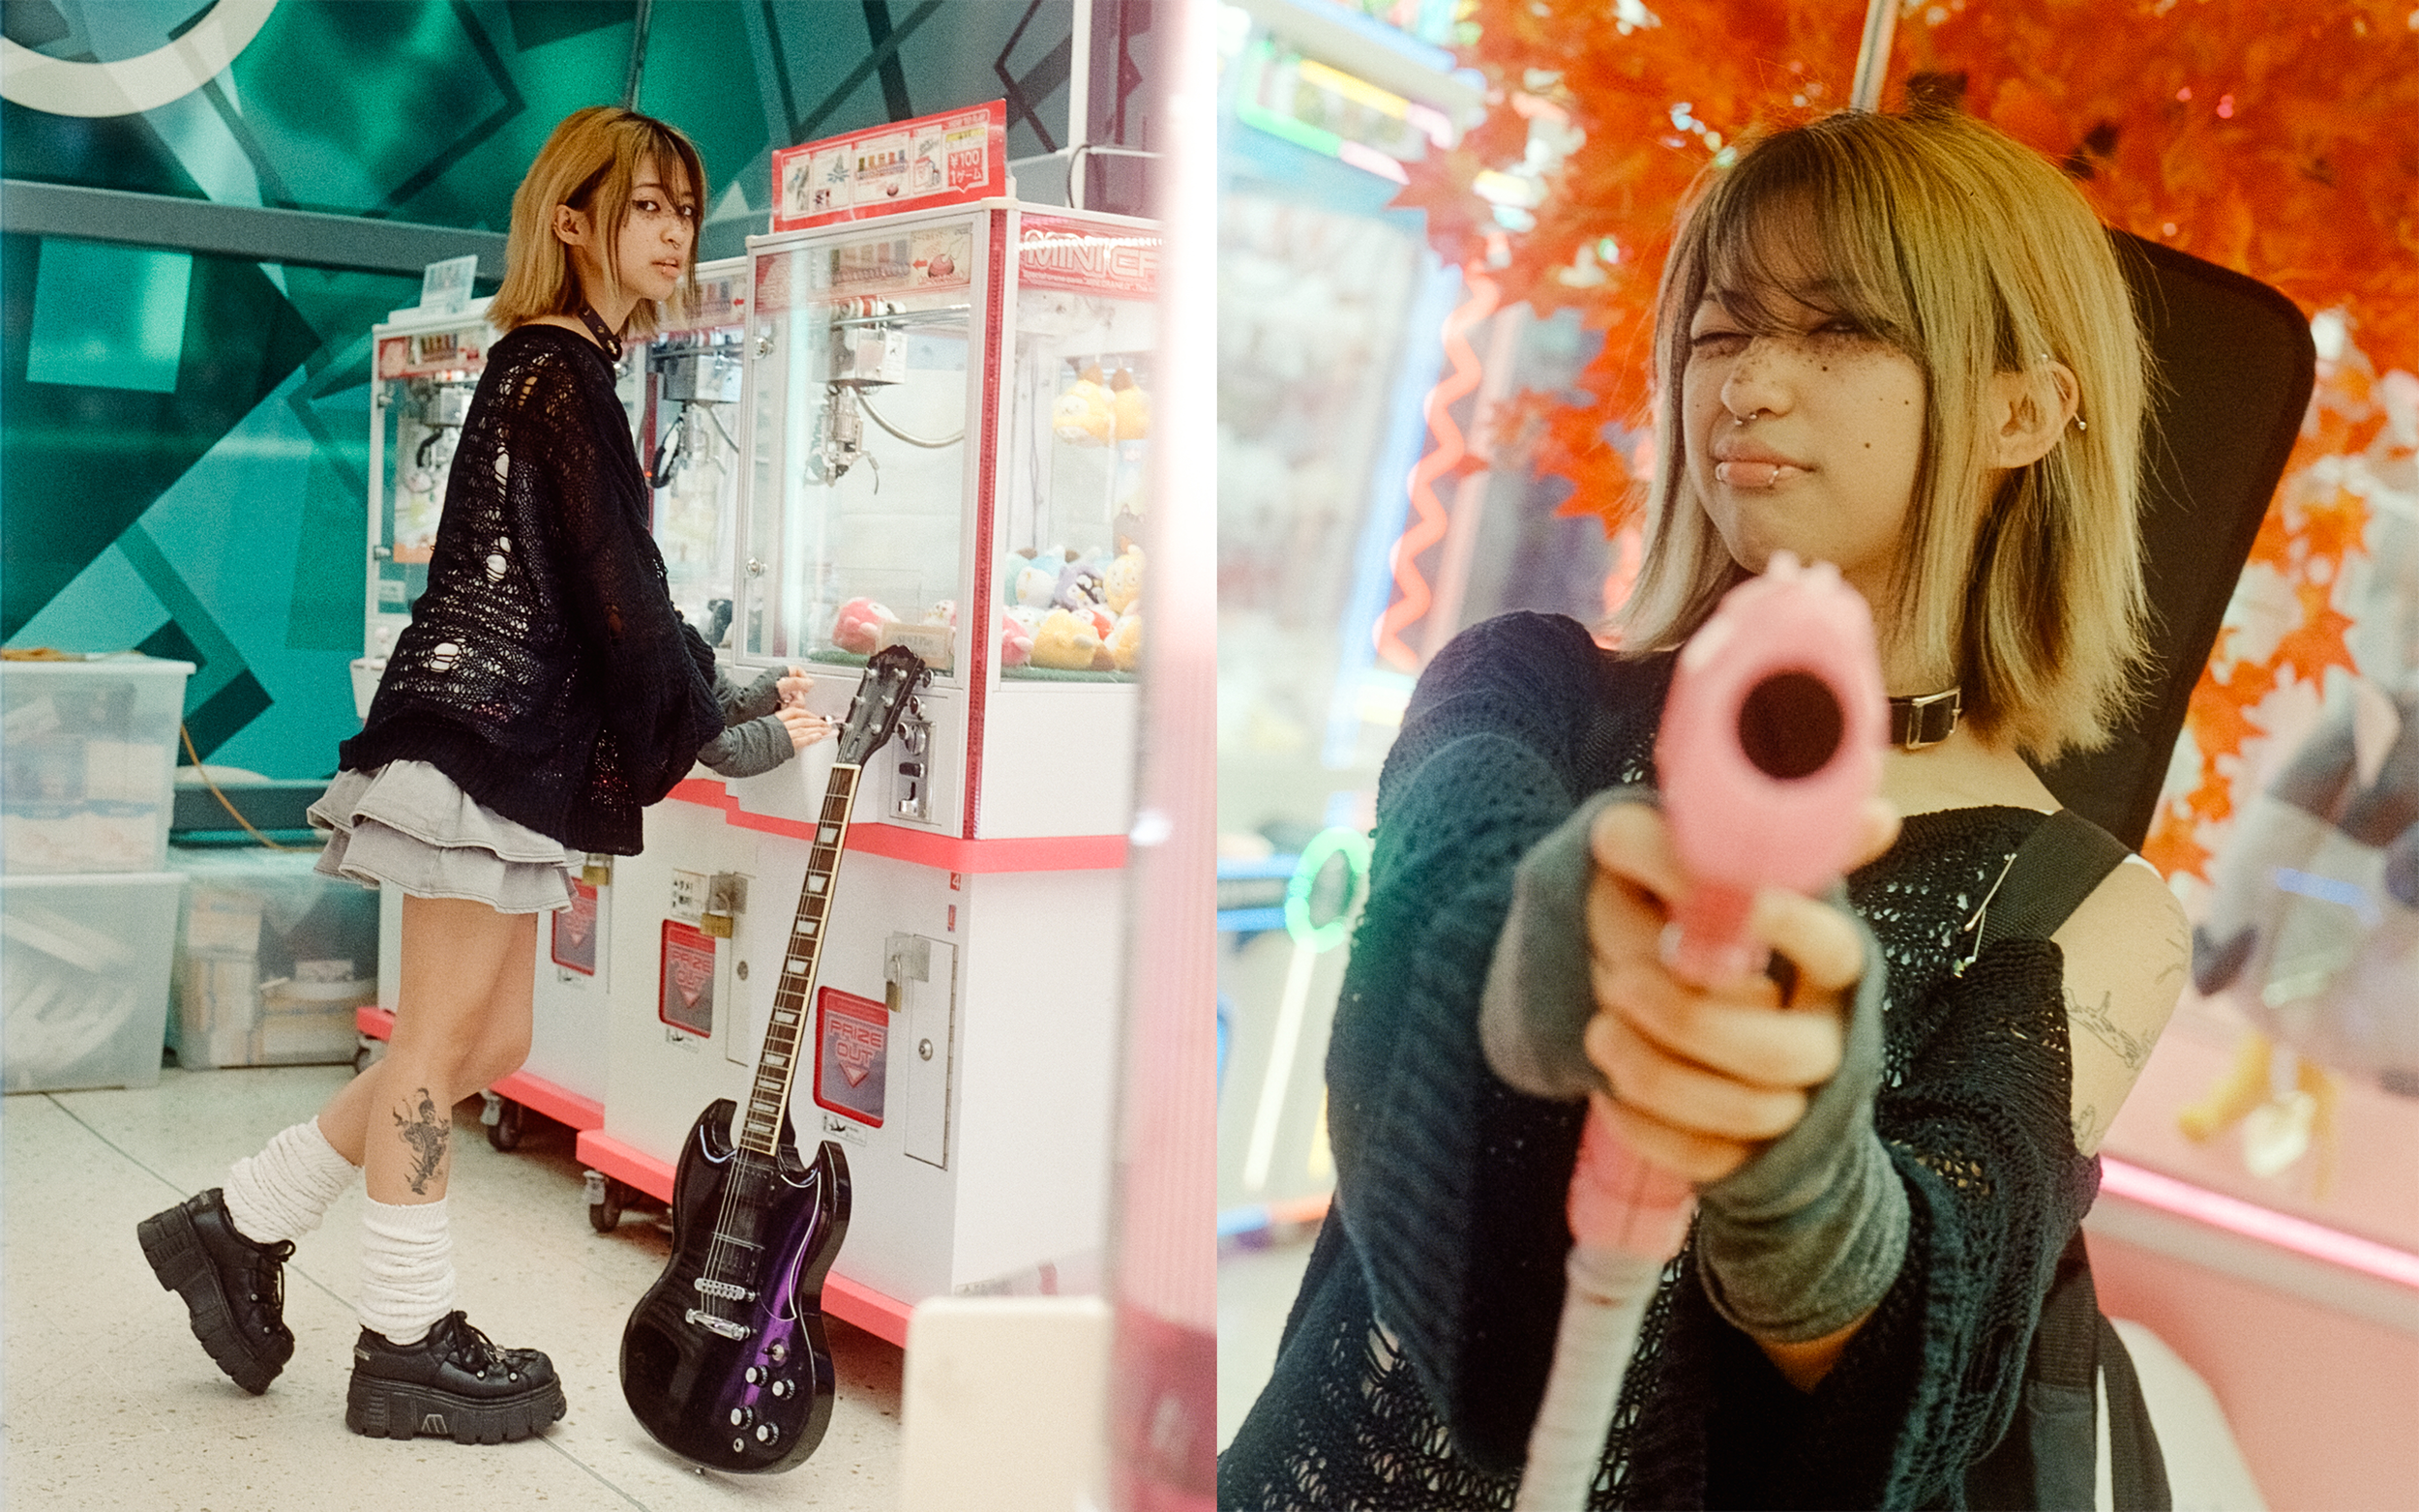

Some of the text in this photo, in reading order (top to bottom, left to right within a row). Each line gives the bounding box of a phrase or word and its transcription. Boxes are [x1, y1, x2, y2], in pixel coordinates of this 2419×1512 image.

[950, 150, 980, 168] ¥100
[950, 167, 982, 184] 1ゲーム
[1024, 232, 1106, 277] MINI
[952, 874, 960, 889] 4
[672, 949, 712, 975] PRIZE
[829, 1019, 883, 1049] PRIZE
[836, 1041, 874, 1064] OUT
